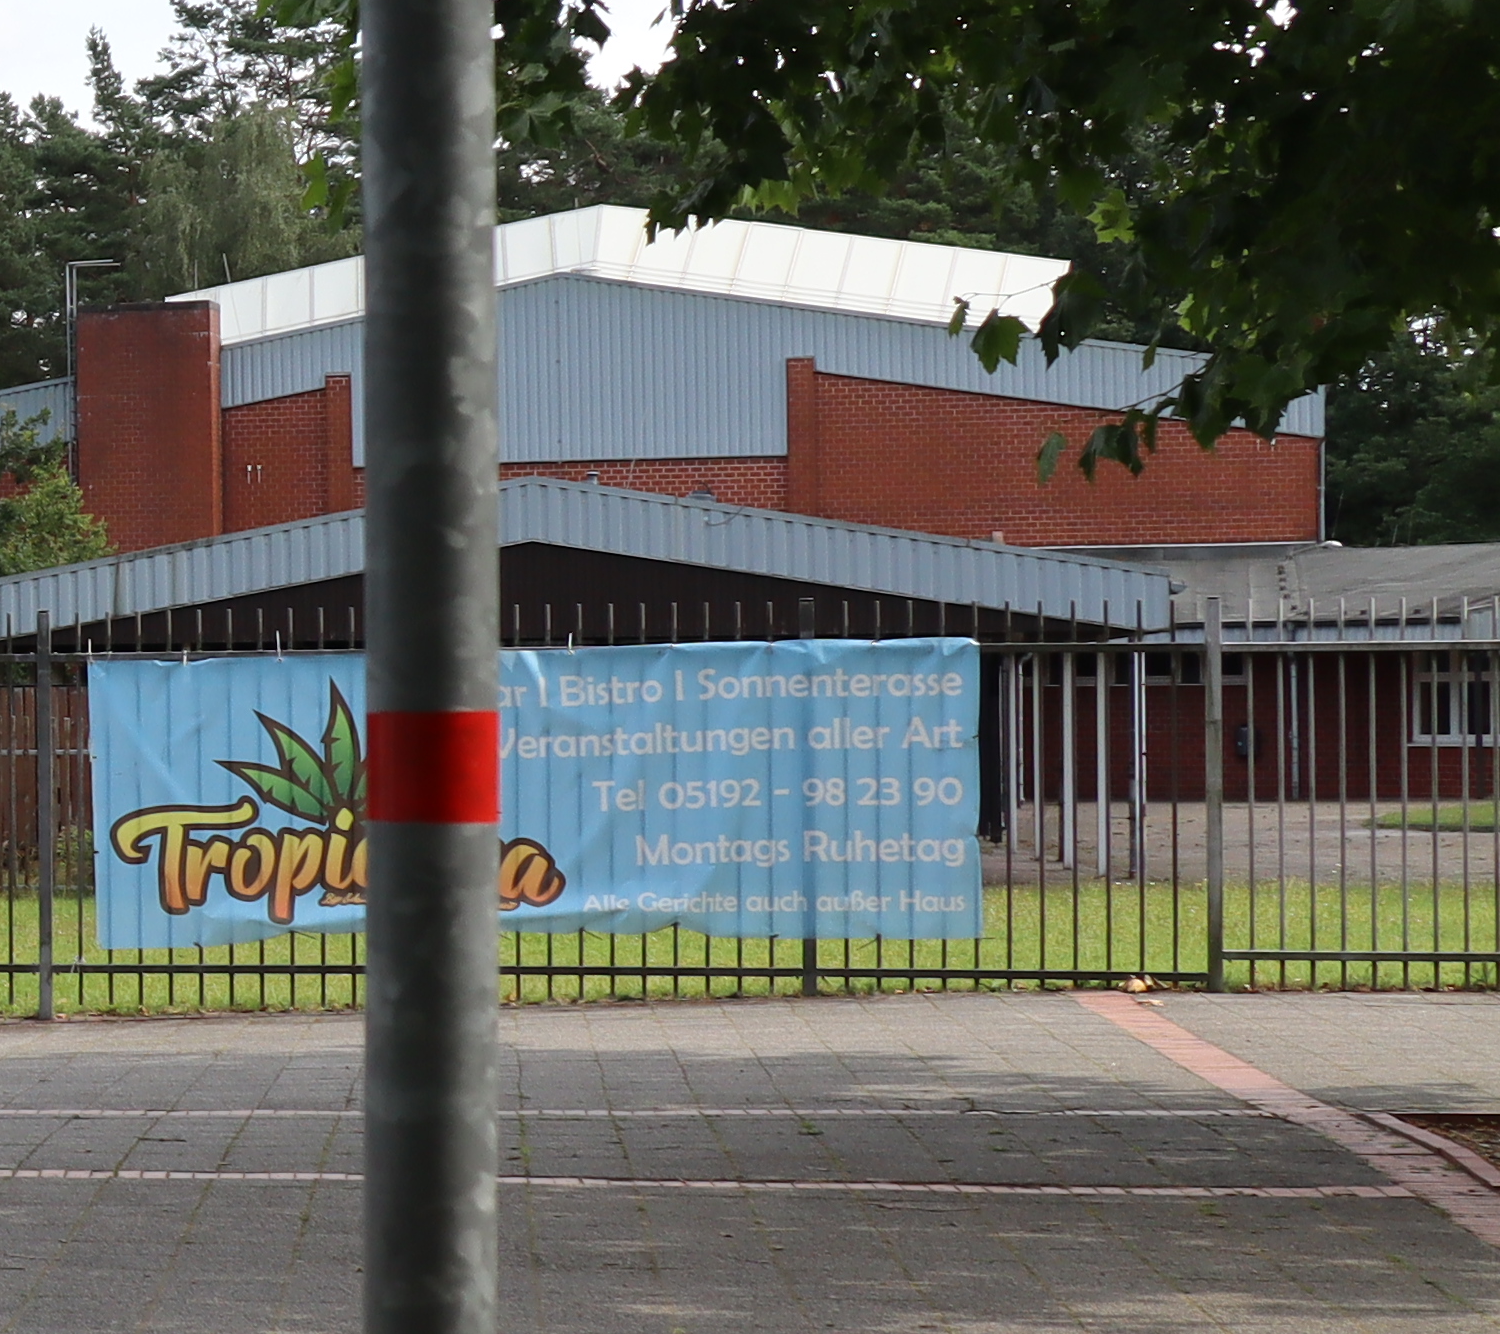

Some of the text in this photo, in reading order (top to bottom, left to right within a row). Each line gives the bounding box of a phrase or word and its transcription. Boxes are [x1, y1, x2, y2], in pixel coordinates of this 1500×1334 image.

[498, 686, 528, 708] ar
[559, 674, 665, 708] Bistro
[697, 668, 965, 701] Sonnenterasse
[808, 717, 891, 750] aller
[901, 715, 965, 750] Art
[592, 779, 647, 813] Tel
[658, 778, 763, 810] 05192
[802, 777, 847, 807] 98
[856, 776, 903, 807] 23
[912, 776, 965, 807] 90
[111, 796, 566, 925] Tropia
[635, 829, 966, 869] Montags Ruhetag
[583, 889, 966, 913] Alle Gerichte auch außer Haus
